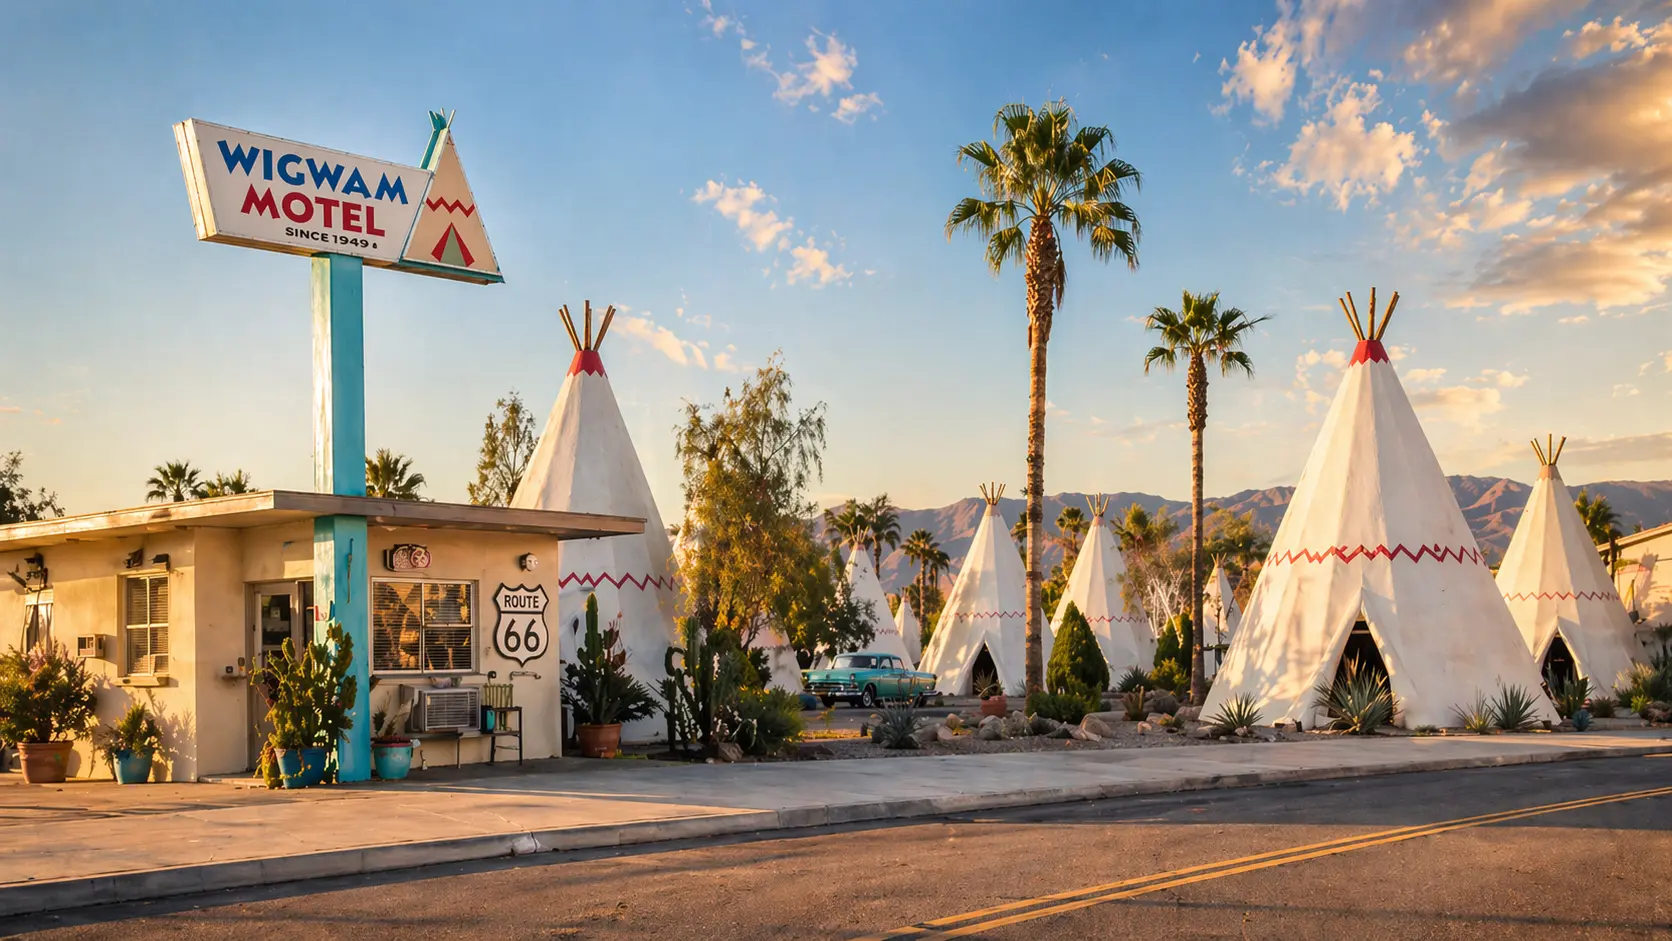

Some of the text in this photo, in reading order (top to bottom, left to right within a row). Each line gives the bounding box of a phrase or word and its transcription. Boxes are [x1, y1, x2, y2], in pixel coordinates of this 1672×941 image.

[217, 140, 409, 205] WIGWAM
[240, 183, 385, 237] MOTEL
[285, 226, 369, 249] SINCE 1949
[504, 594, 540, 609] ROUTE
[504, 618, 541, 653] 66
